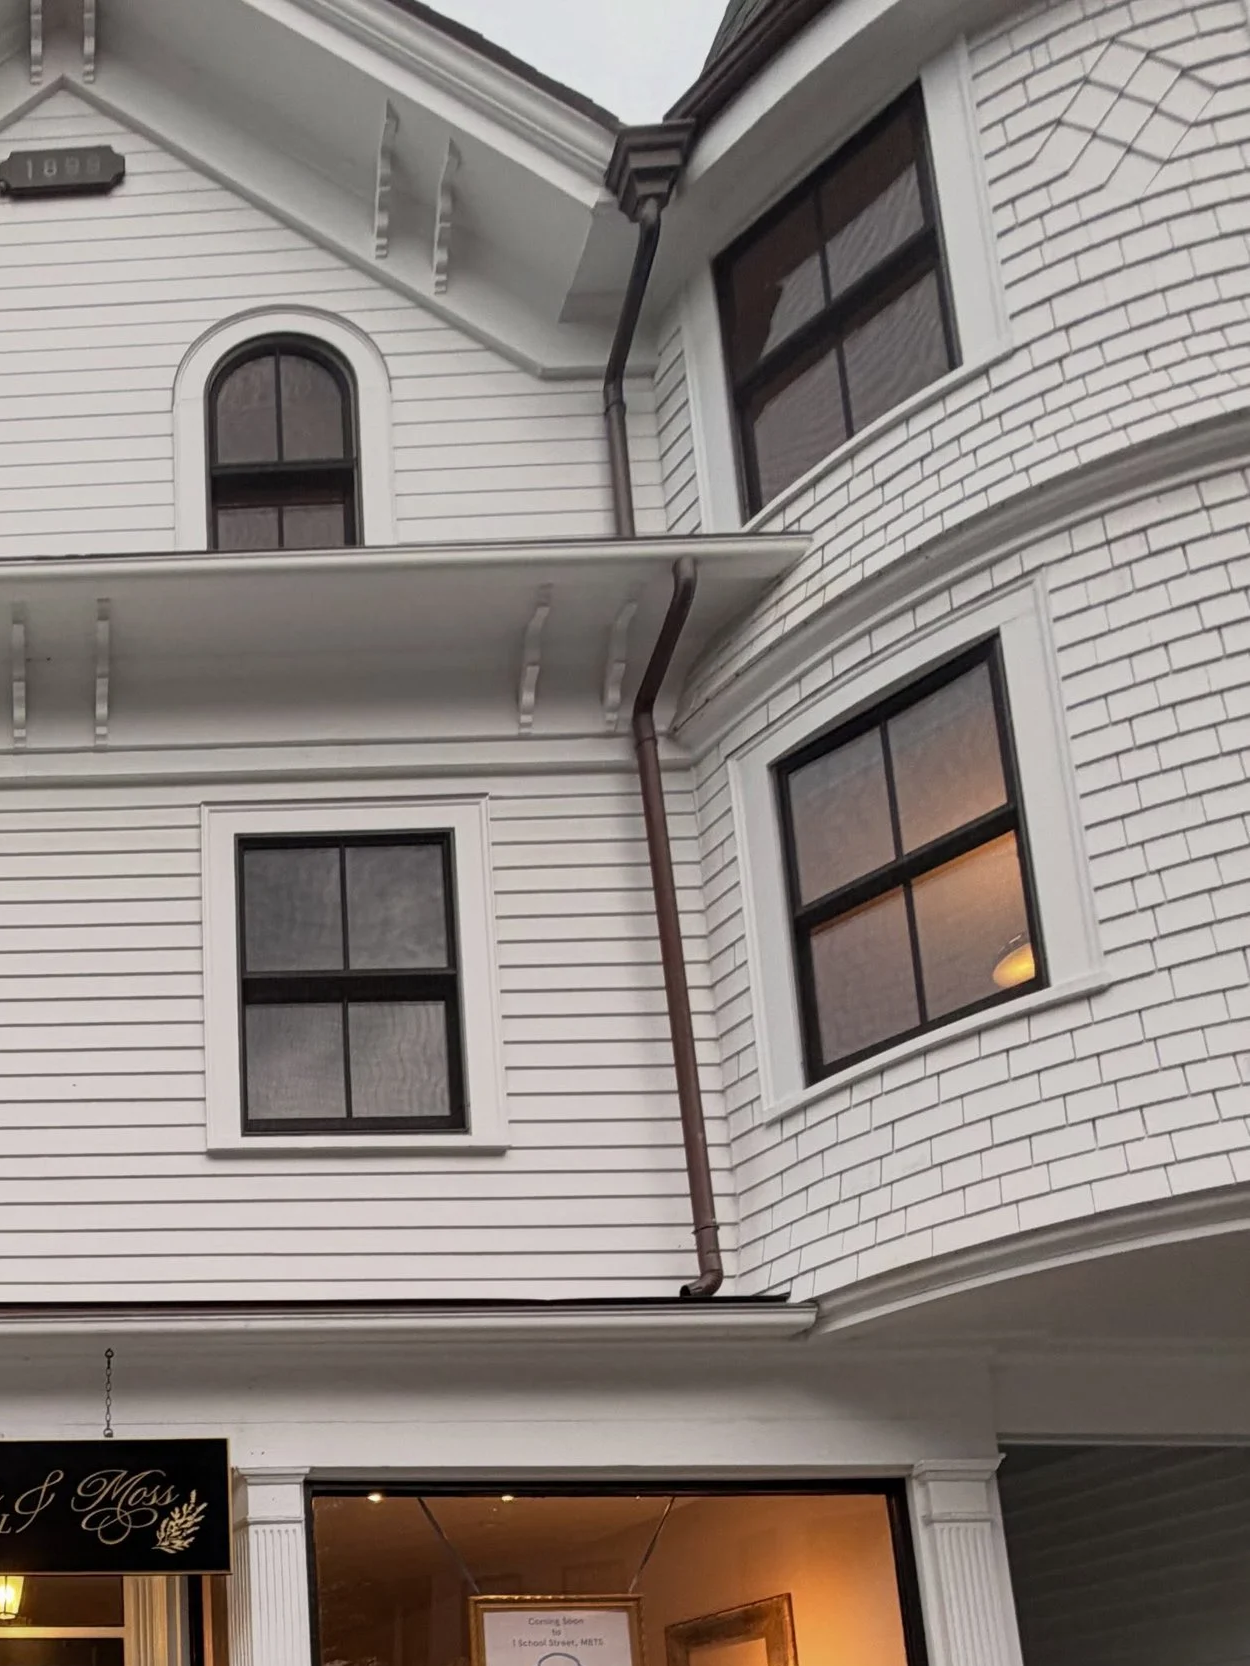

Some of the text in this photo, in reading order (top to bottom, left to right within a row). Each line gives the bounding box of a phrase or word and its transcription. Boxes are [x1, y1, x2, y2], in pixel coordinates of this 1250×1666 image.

[71, 1469, 179, 1545] Moss
[528, 1616, 584, 1626] Coming Soon
[518, 1639, 547, 1647] School
[549, 1639, 579, 1647] Street,
